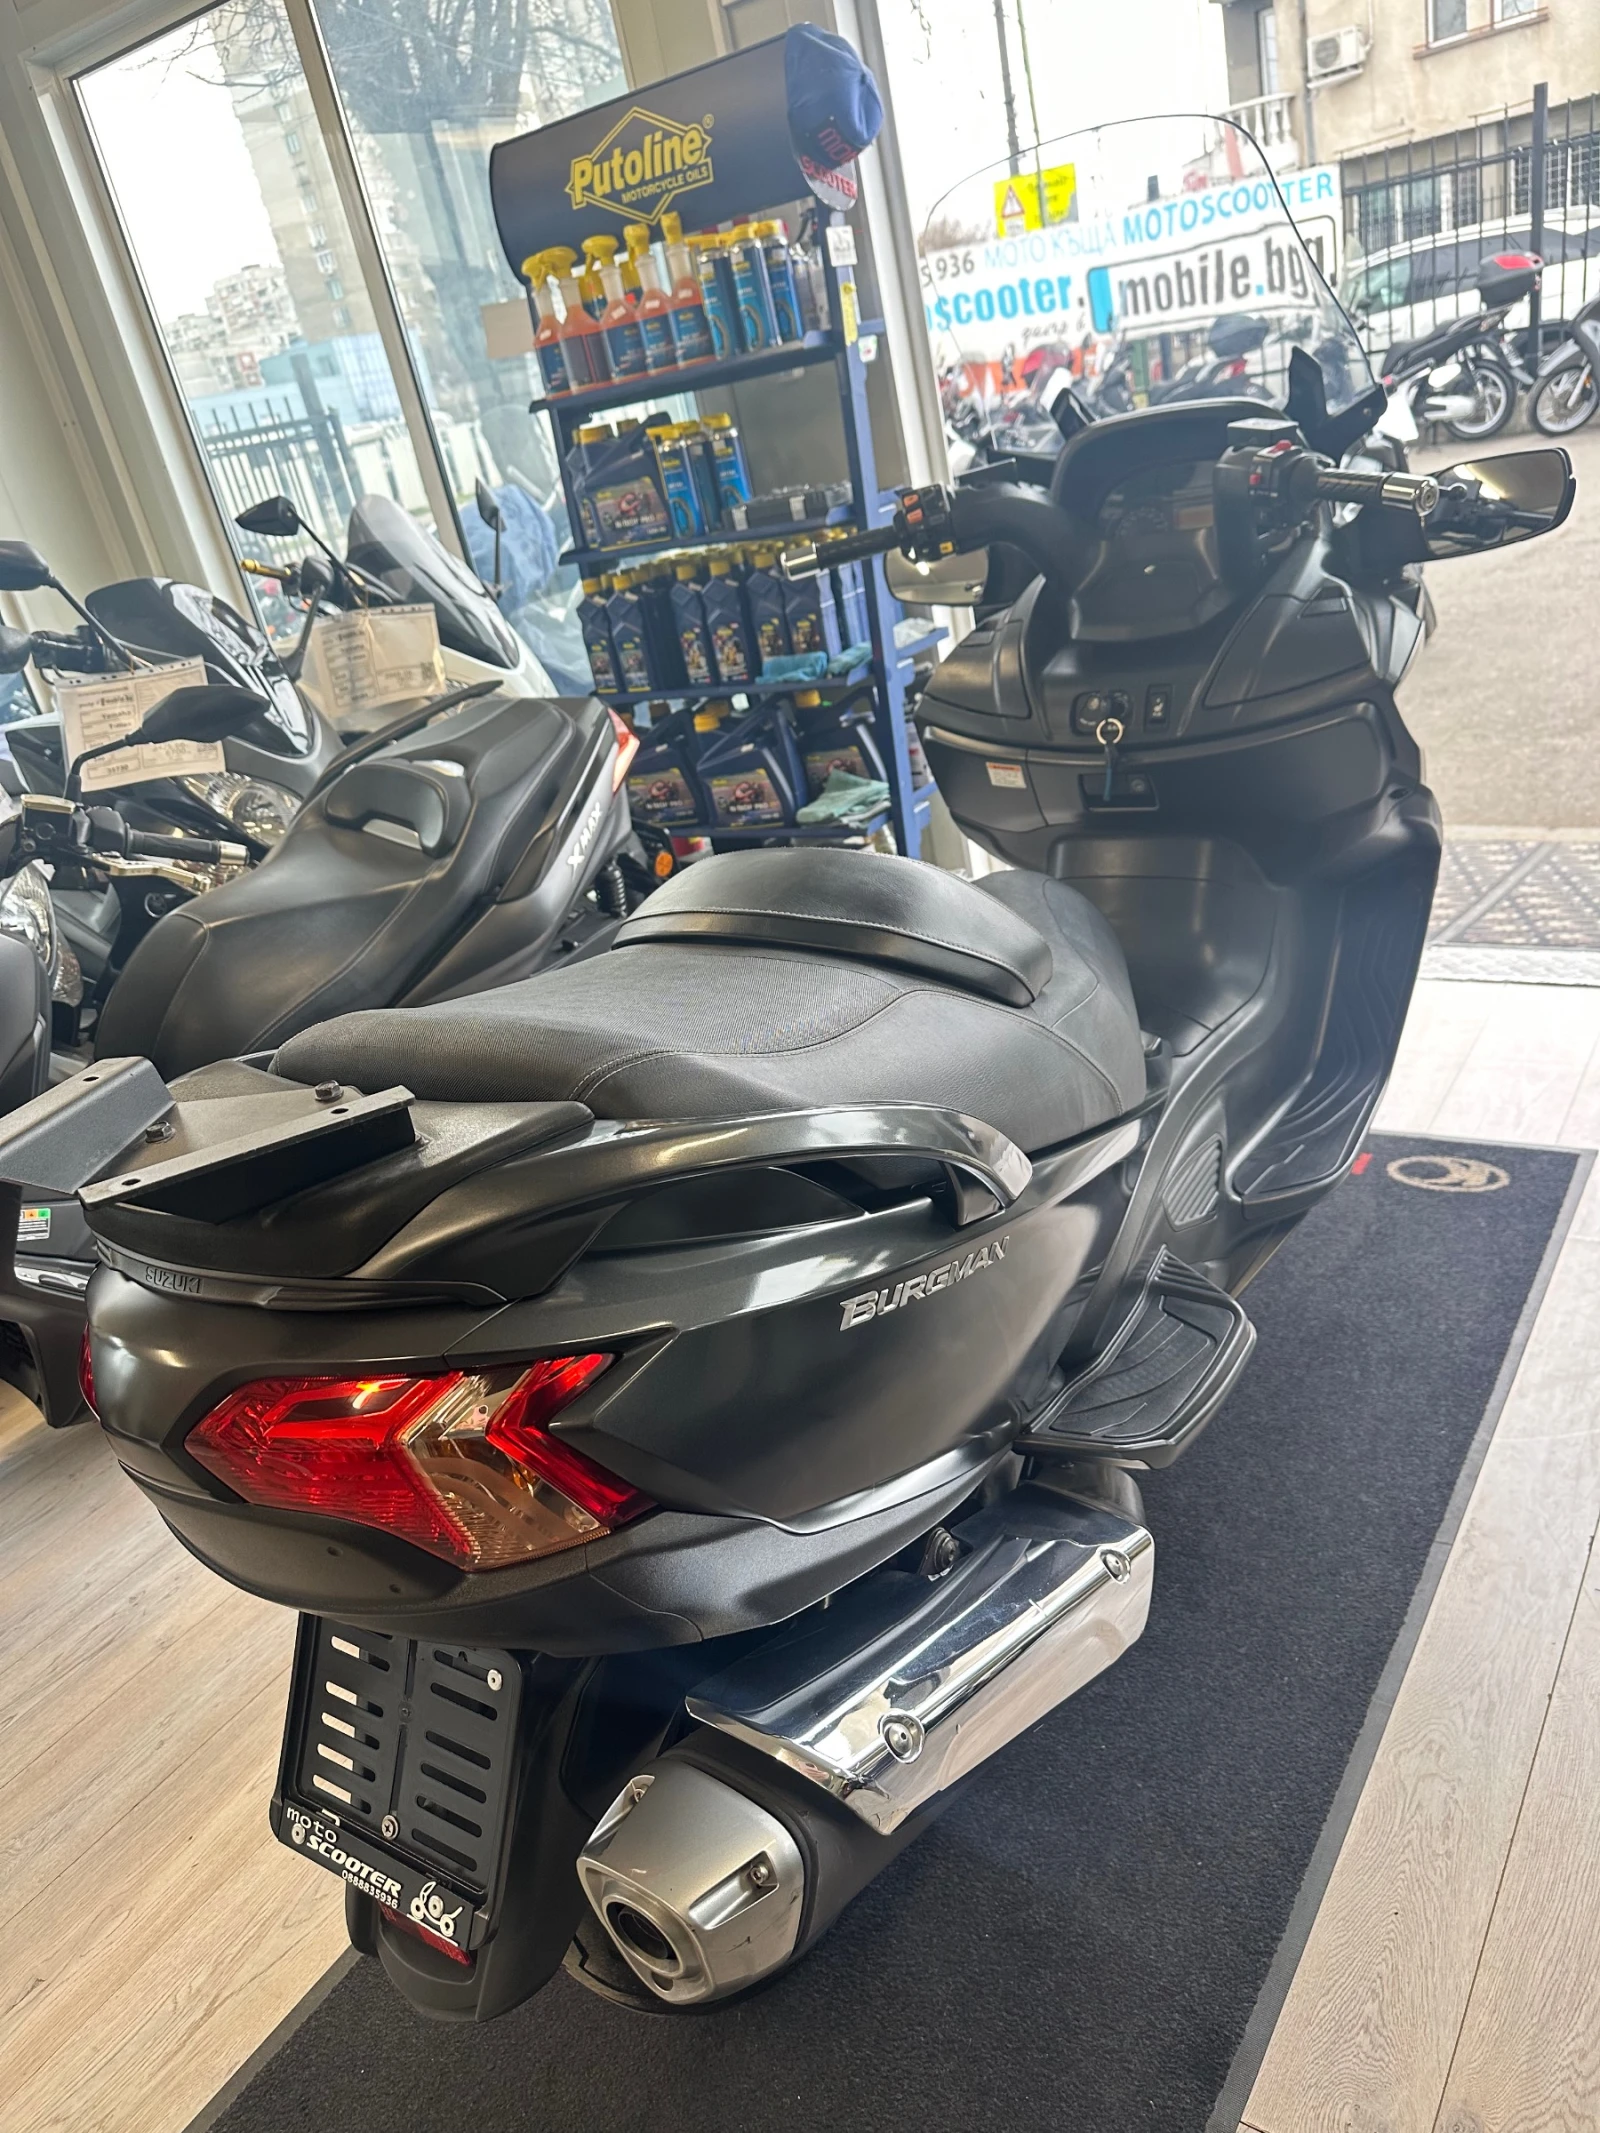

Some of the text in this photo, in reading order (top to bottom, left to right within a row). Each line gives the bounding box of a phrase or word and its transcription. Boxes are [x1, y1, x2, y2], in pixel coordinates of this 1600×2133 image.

[574, 130, 703, 204] Putoline
[621, 166, 709, 204] MOTORCYCLE OILS
[935, 250, 975, 281] 936
[145, 1265, 202, 1294] SUZUKI
[839, 1235, 1010, 1332] BURGMAN
[286, 1805, 339, 1844] moto
[306, 1834, 402, 1898] SCOOTER
[341, 1868, 399, 1910] 0888835936
